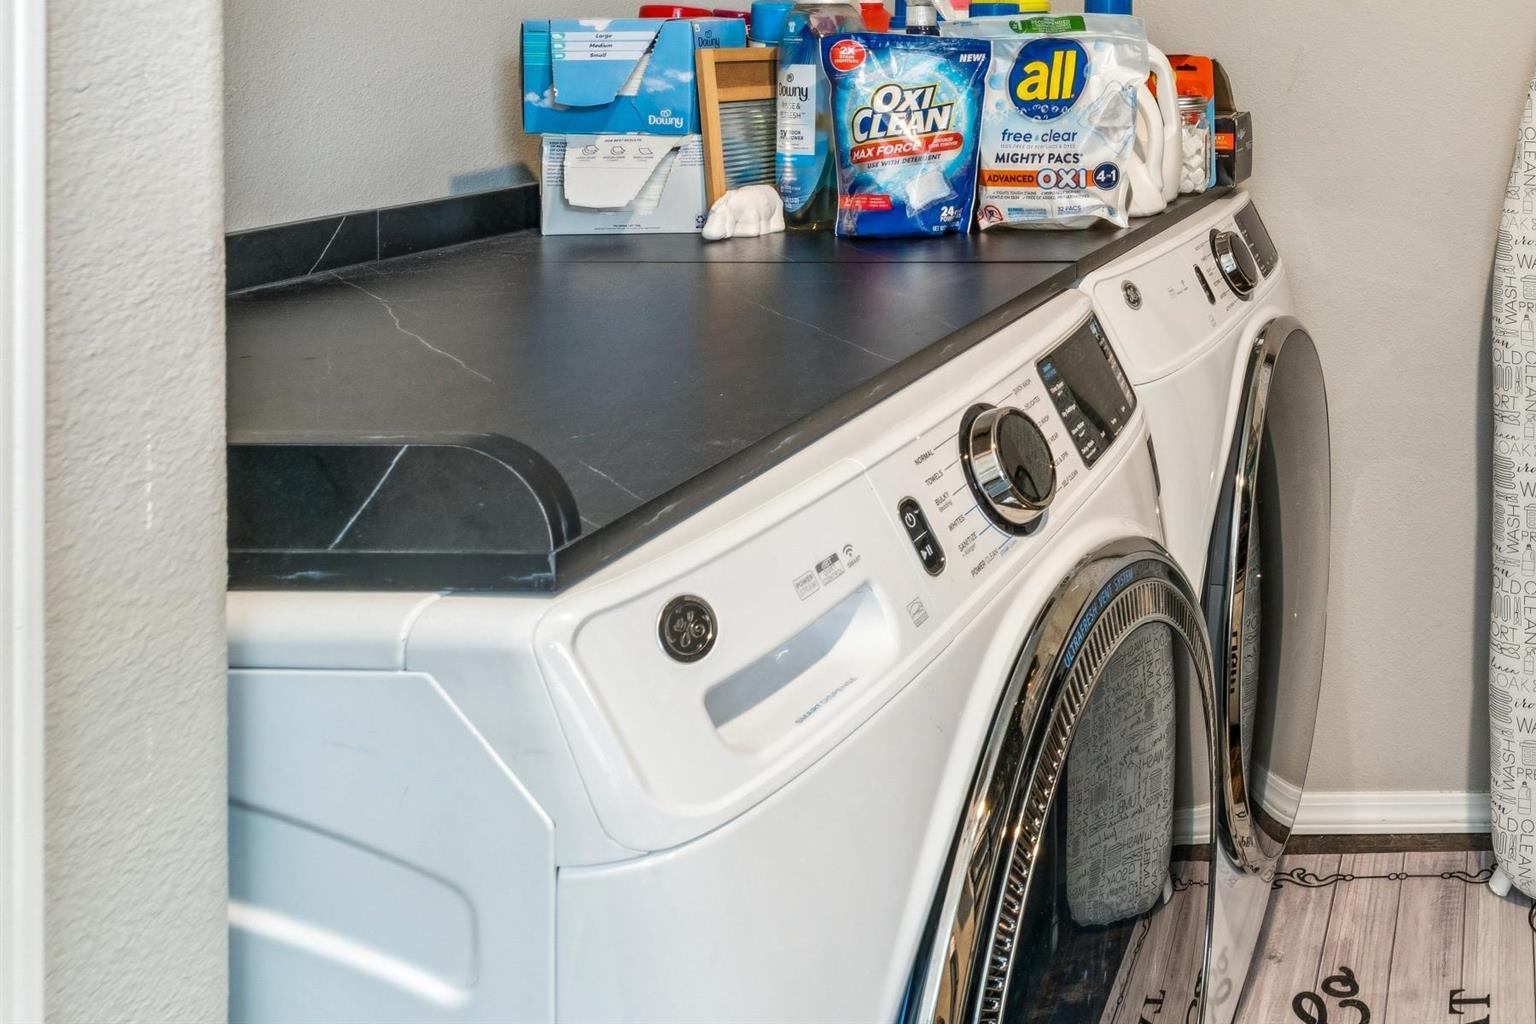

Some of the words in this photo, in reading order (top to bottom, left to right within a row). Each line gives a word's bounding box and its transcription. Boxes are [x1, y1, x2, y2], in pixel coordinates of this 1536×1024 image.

[959, 53, 985, 63] NEW!
[1016, 50, 1077, 101] all
[872, 84, 938, 113] OXI
[648, 115, 683, 128] Downy
[852, 103, 954, 144] CLEAN
[1001, 129, 1032, 142] free
[1041, 130, 1077, 142] clear
[853, 146, 875, 160] MAX
[876, 142, 922, 156] FORCE
[995, 153, 1045, 165] MIGHTY
[1048, 153, 1080, 164] PACS
[881, 159, 900, 167] WITH
[1524, 129, 1536, 192] CLEAN
[987, 175, 1034, 183] ADVANCED
[1037, 168, 1088, 190] OXI
[1504, 276, 1517, 324] WASH
[914, 449, 935, 466] NORMAL
[925, 470, 943, 487] TOWELS
[935, 492, 949, 506] BULKY
[949, 515, 966, 531] WHITES
[958, 532, 977, 552] SANITIZE
[971, 559, 986, 577] POWER
